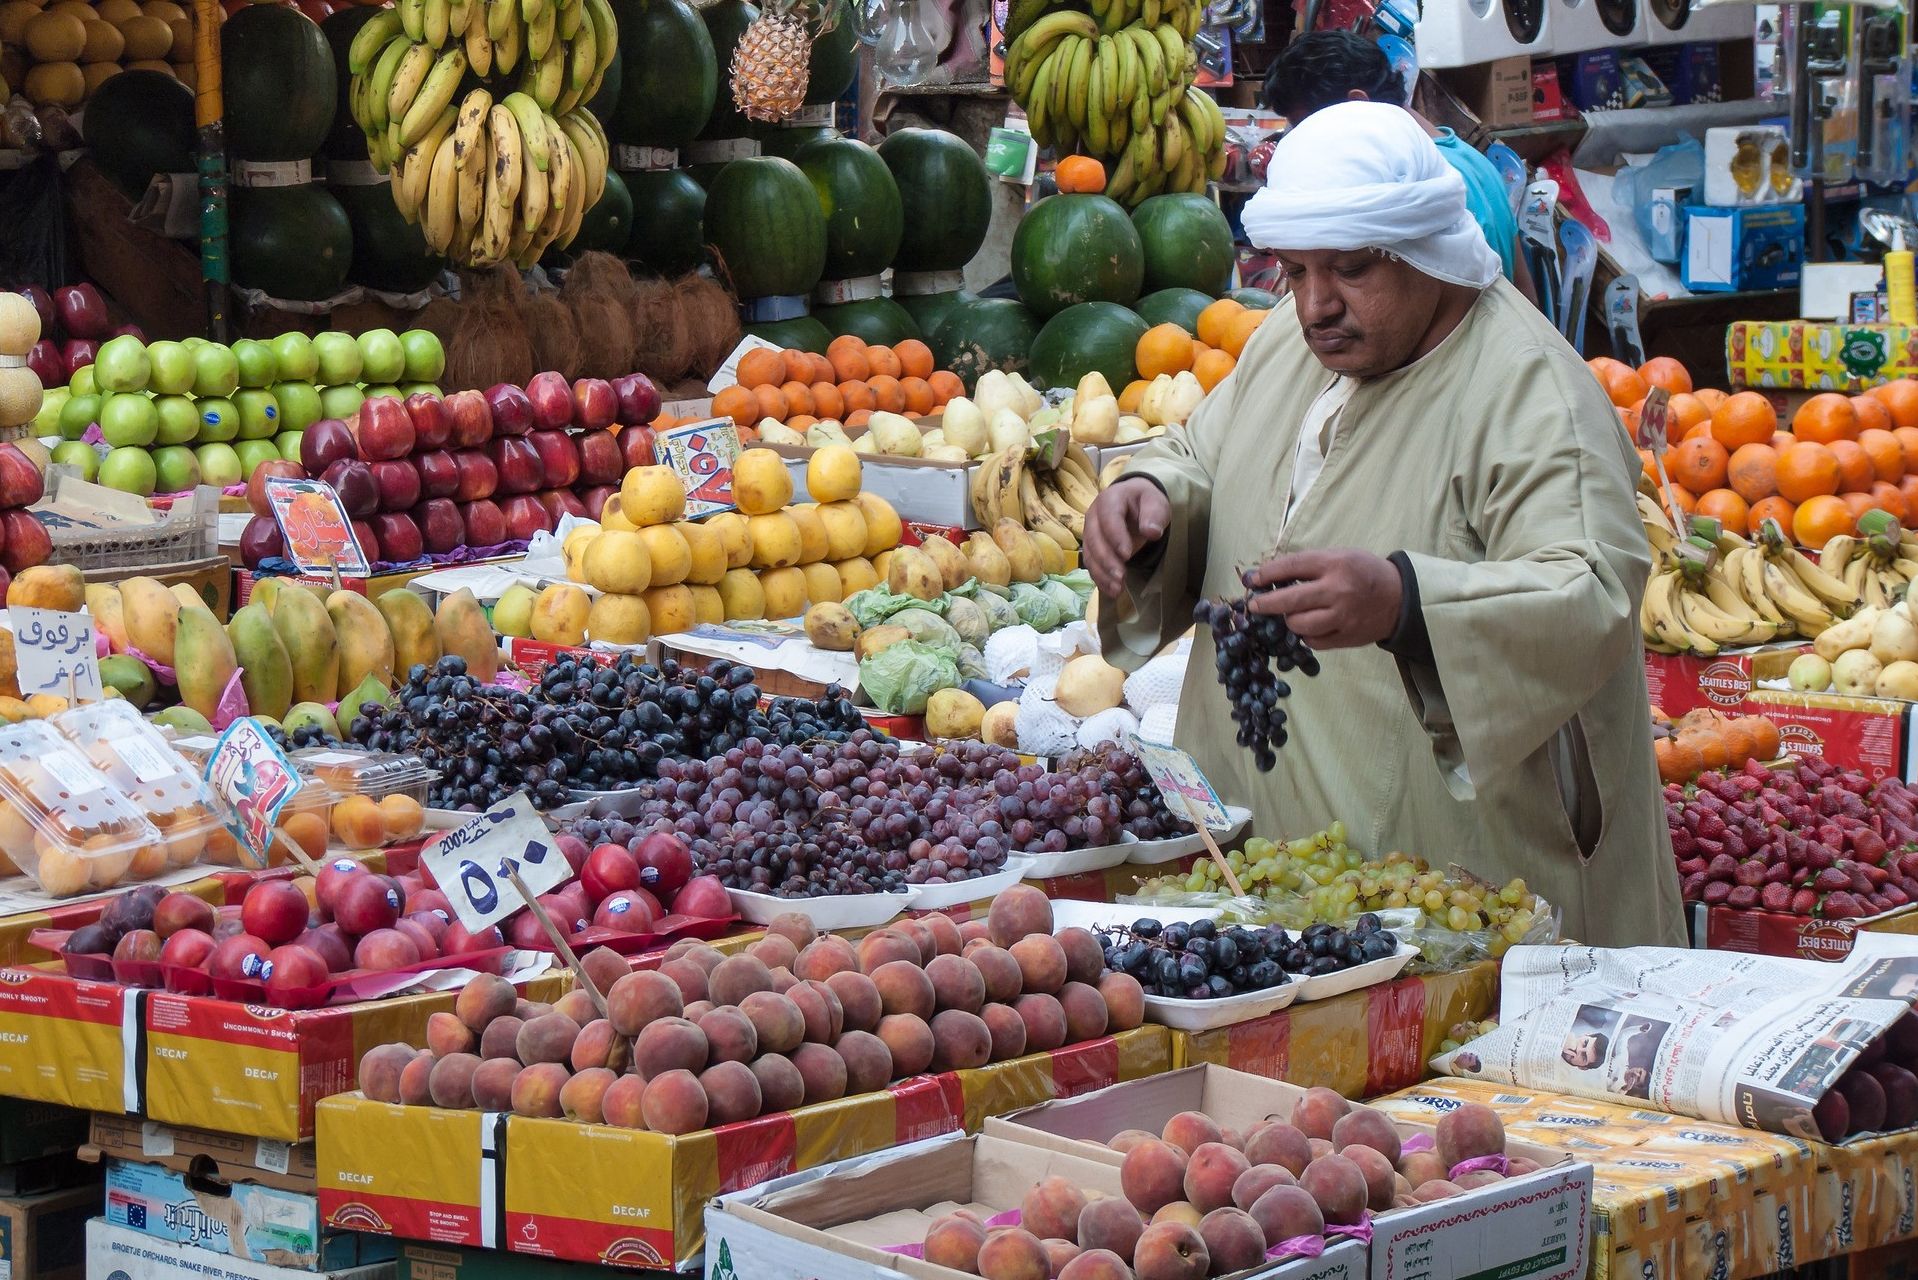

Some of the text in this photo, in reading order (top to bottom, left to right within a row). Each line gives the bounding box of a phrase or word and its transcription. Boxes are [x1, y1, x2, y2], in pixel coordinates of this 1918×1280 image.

[18, 611, 90, 655] برقوق
[1699, 675, 1752, 691] SEATTLE'S BEST
[1708, 691, 1741, 704] COFFEE
[439, 828, 472, 857] 2002
[1797, 934, 1855, 951] ATTLE'S BEST
[223, 1022, 269, 1036] UNCOMMONLY
[155, 1046, 188, 1060] DECAF
[244, 1067, 279, 1081] DECAF
[338, 1171, 374, 1185] DECAF
[612, 1204, 651, 1219] DECAF
[111, 1241, 142, 1257] BROETJE
[179, 1260, 201, 1273] SNAKE
[202, 1265, 224, 1278] RIVER,
